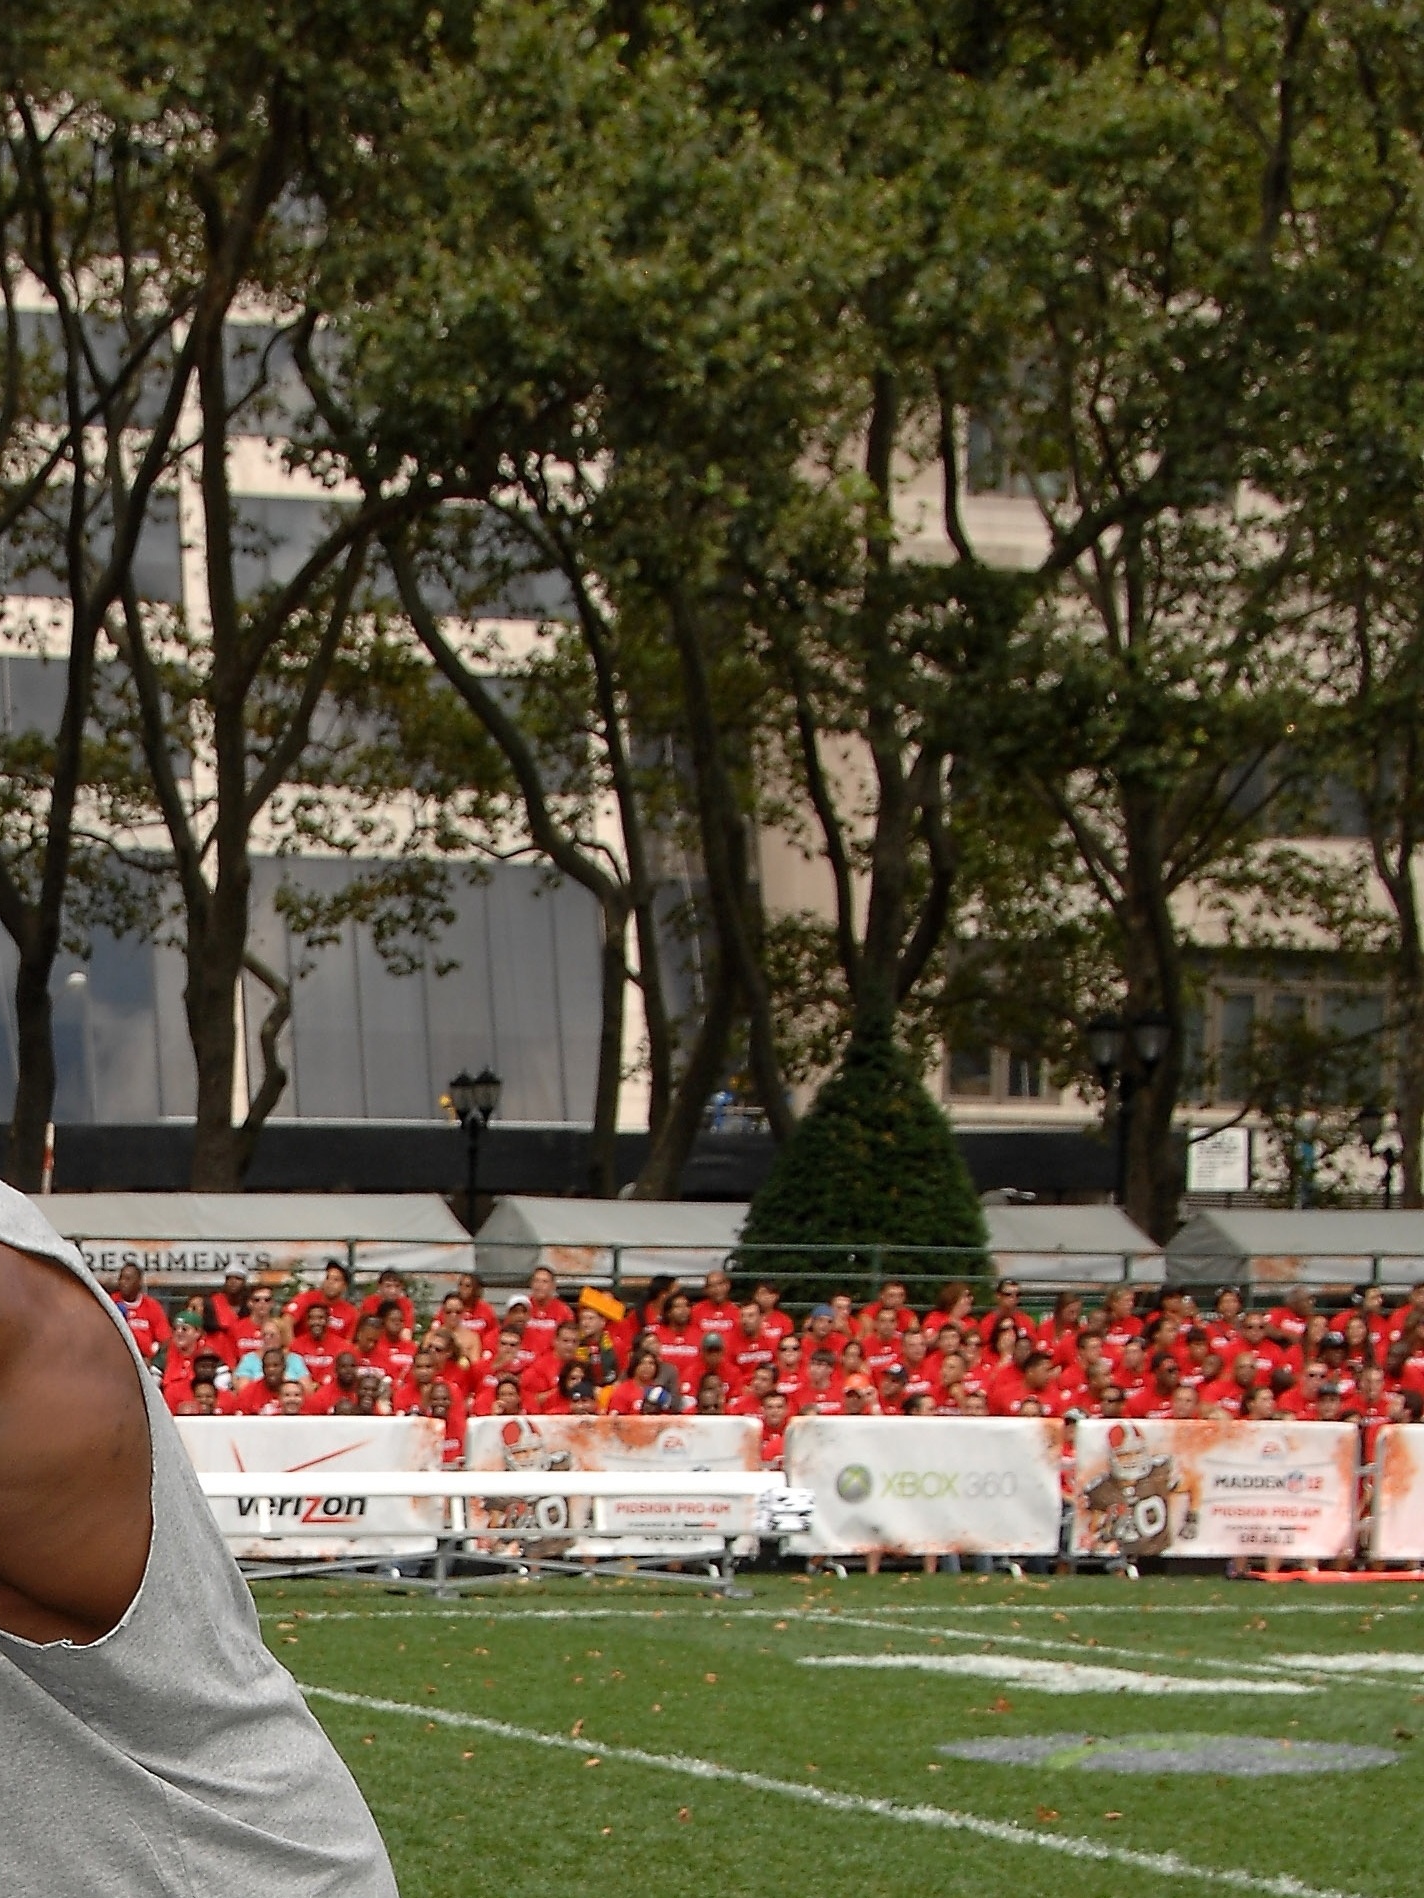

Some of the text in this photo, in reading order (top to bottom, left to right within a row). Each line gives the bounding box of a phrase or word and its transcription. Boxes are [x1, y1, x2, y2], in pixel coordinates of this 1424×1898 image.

[880, 1471, 1018, 1497] XBOX 360
[1214, 1475, 1286, 1489] MADDEN
